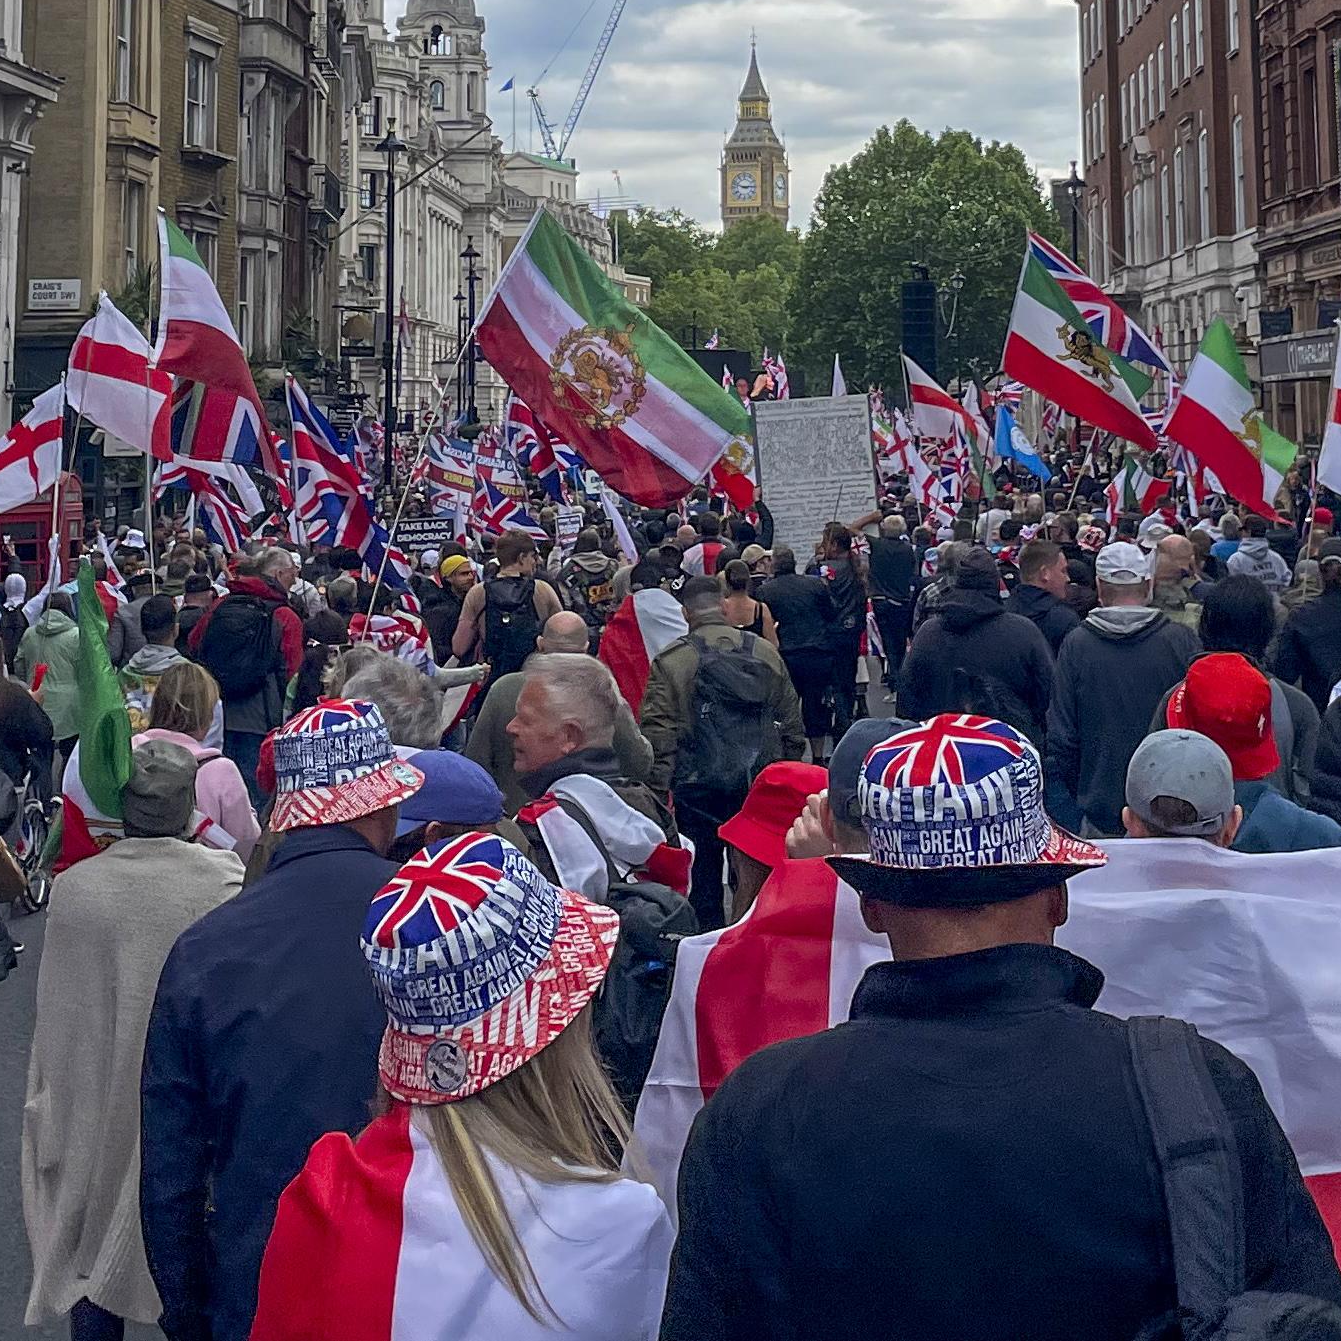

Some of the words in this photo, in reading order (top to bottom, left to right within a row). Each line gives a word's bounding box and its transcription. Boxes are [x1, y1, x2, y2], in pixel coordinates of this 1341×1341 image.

[32, 292, 57, 300] COURT
[399, 522, 422, 531] TAKE
[423, 520, 448, 529] BACK
[396, 531, 451, 542] DEMOCRACY
[920, 826, 973, 854] GREAT
[980, 816, 1025, 848] AGAIN
[405, 971, 457, 999] GREAT
[463, 950, 512, 988] AGAIN
[430, 987, 483, 1017] GREAT
